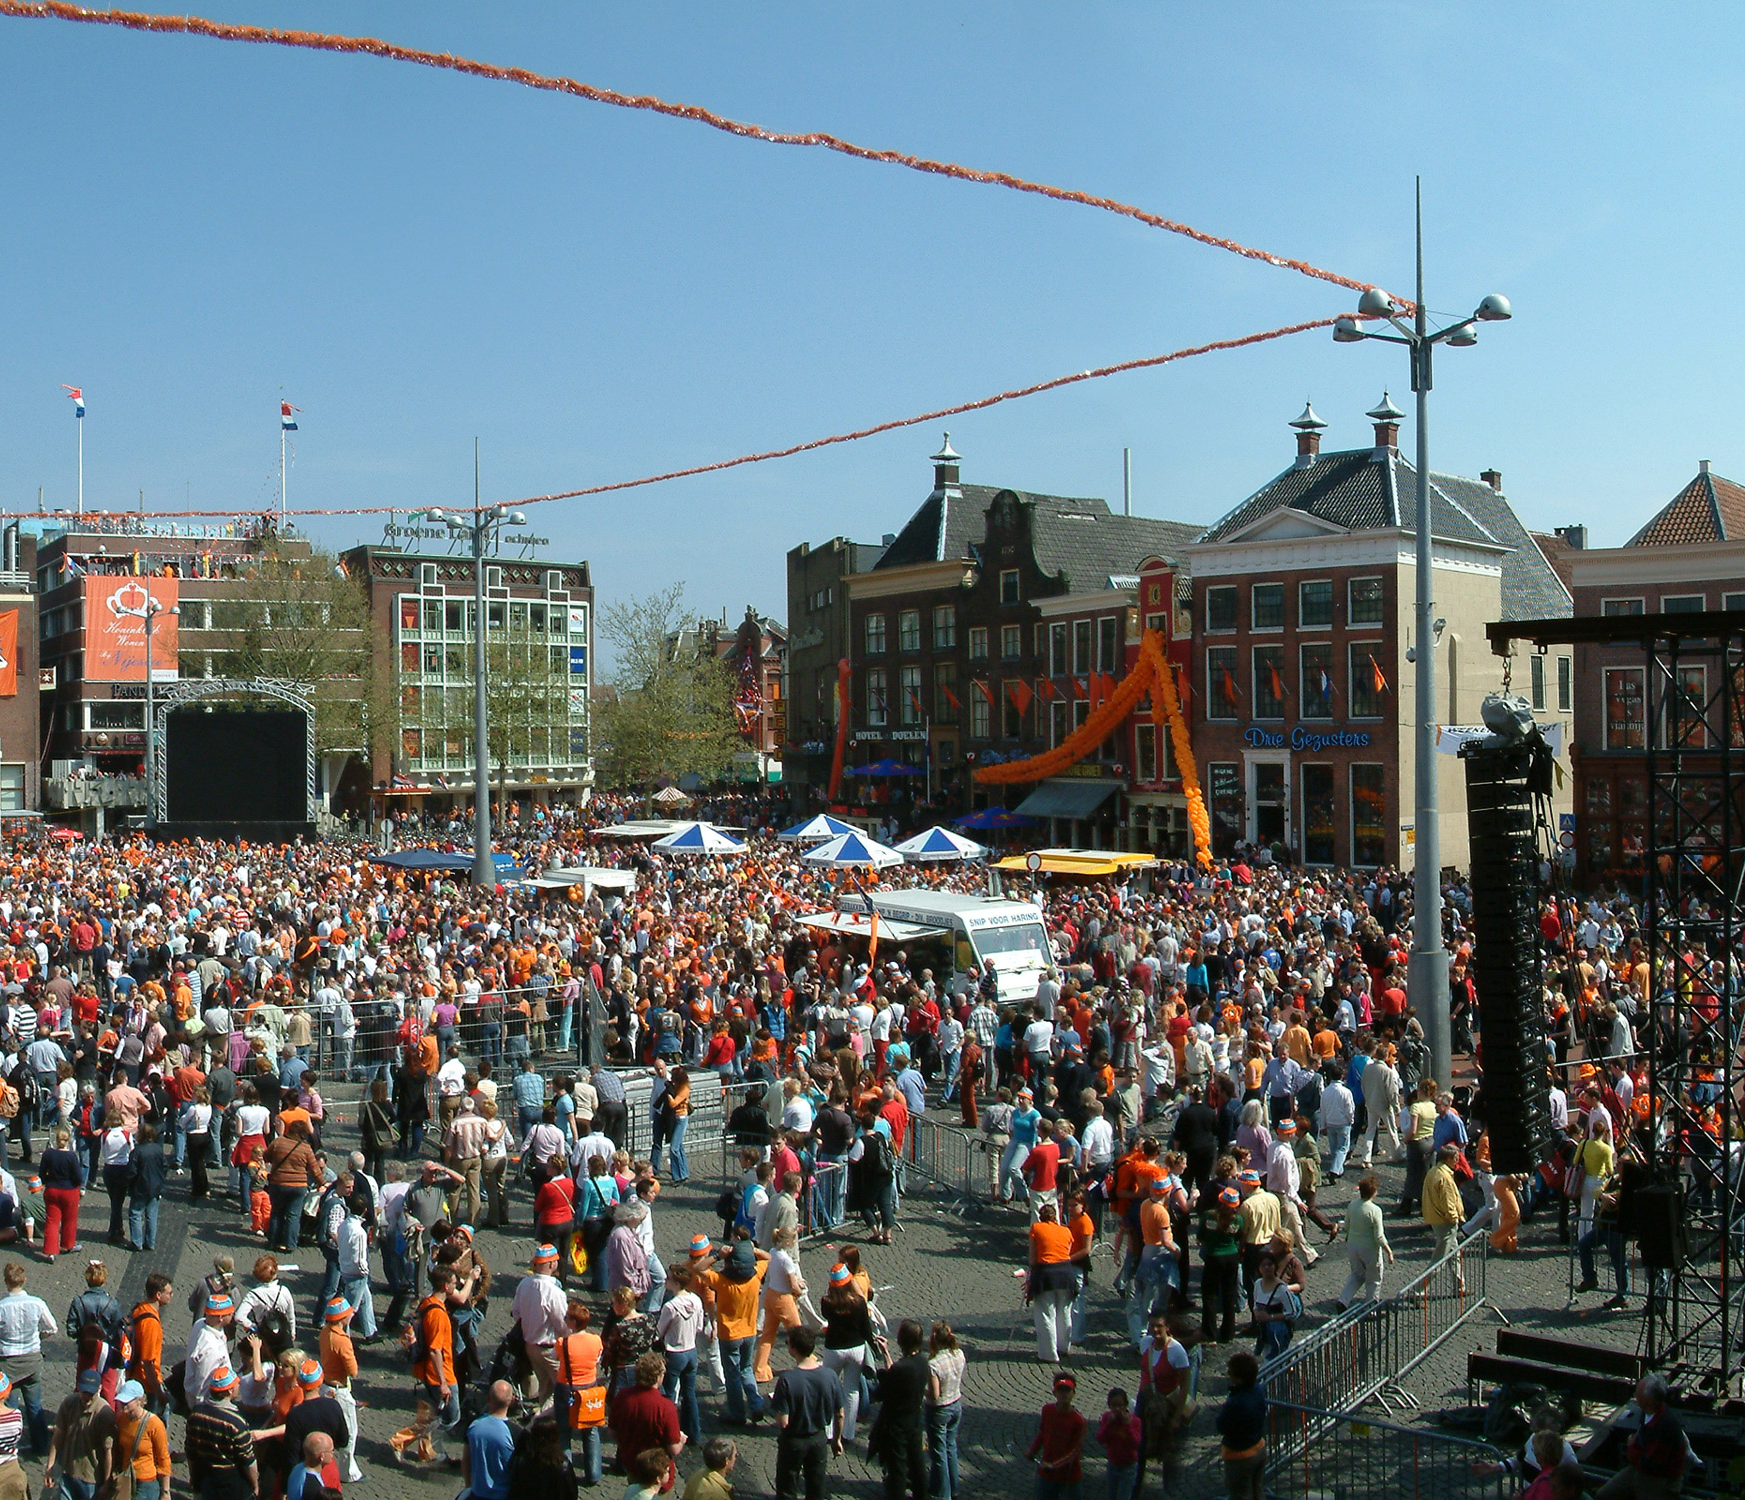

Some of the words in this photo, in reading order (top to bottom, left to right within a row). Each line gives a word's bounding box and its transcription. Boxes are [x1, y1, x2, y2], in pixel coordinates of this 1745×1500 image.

[384, 523, 446, 539] Groene
[855, 731, 884, 740] HOTEL
[892, 731, 927, 740] DOELEN
[1244, 726, 1285, 747] Drie
[1291, 725, 1371, 752] Gezusters
[969, 917, 986, 927] SNIP
[988, 915, 1010, 925] VOOR
[1011, 912, 1039, 923] HARING
